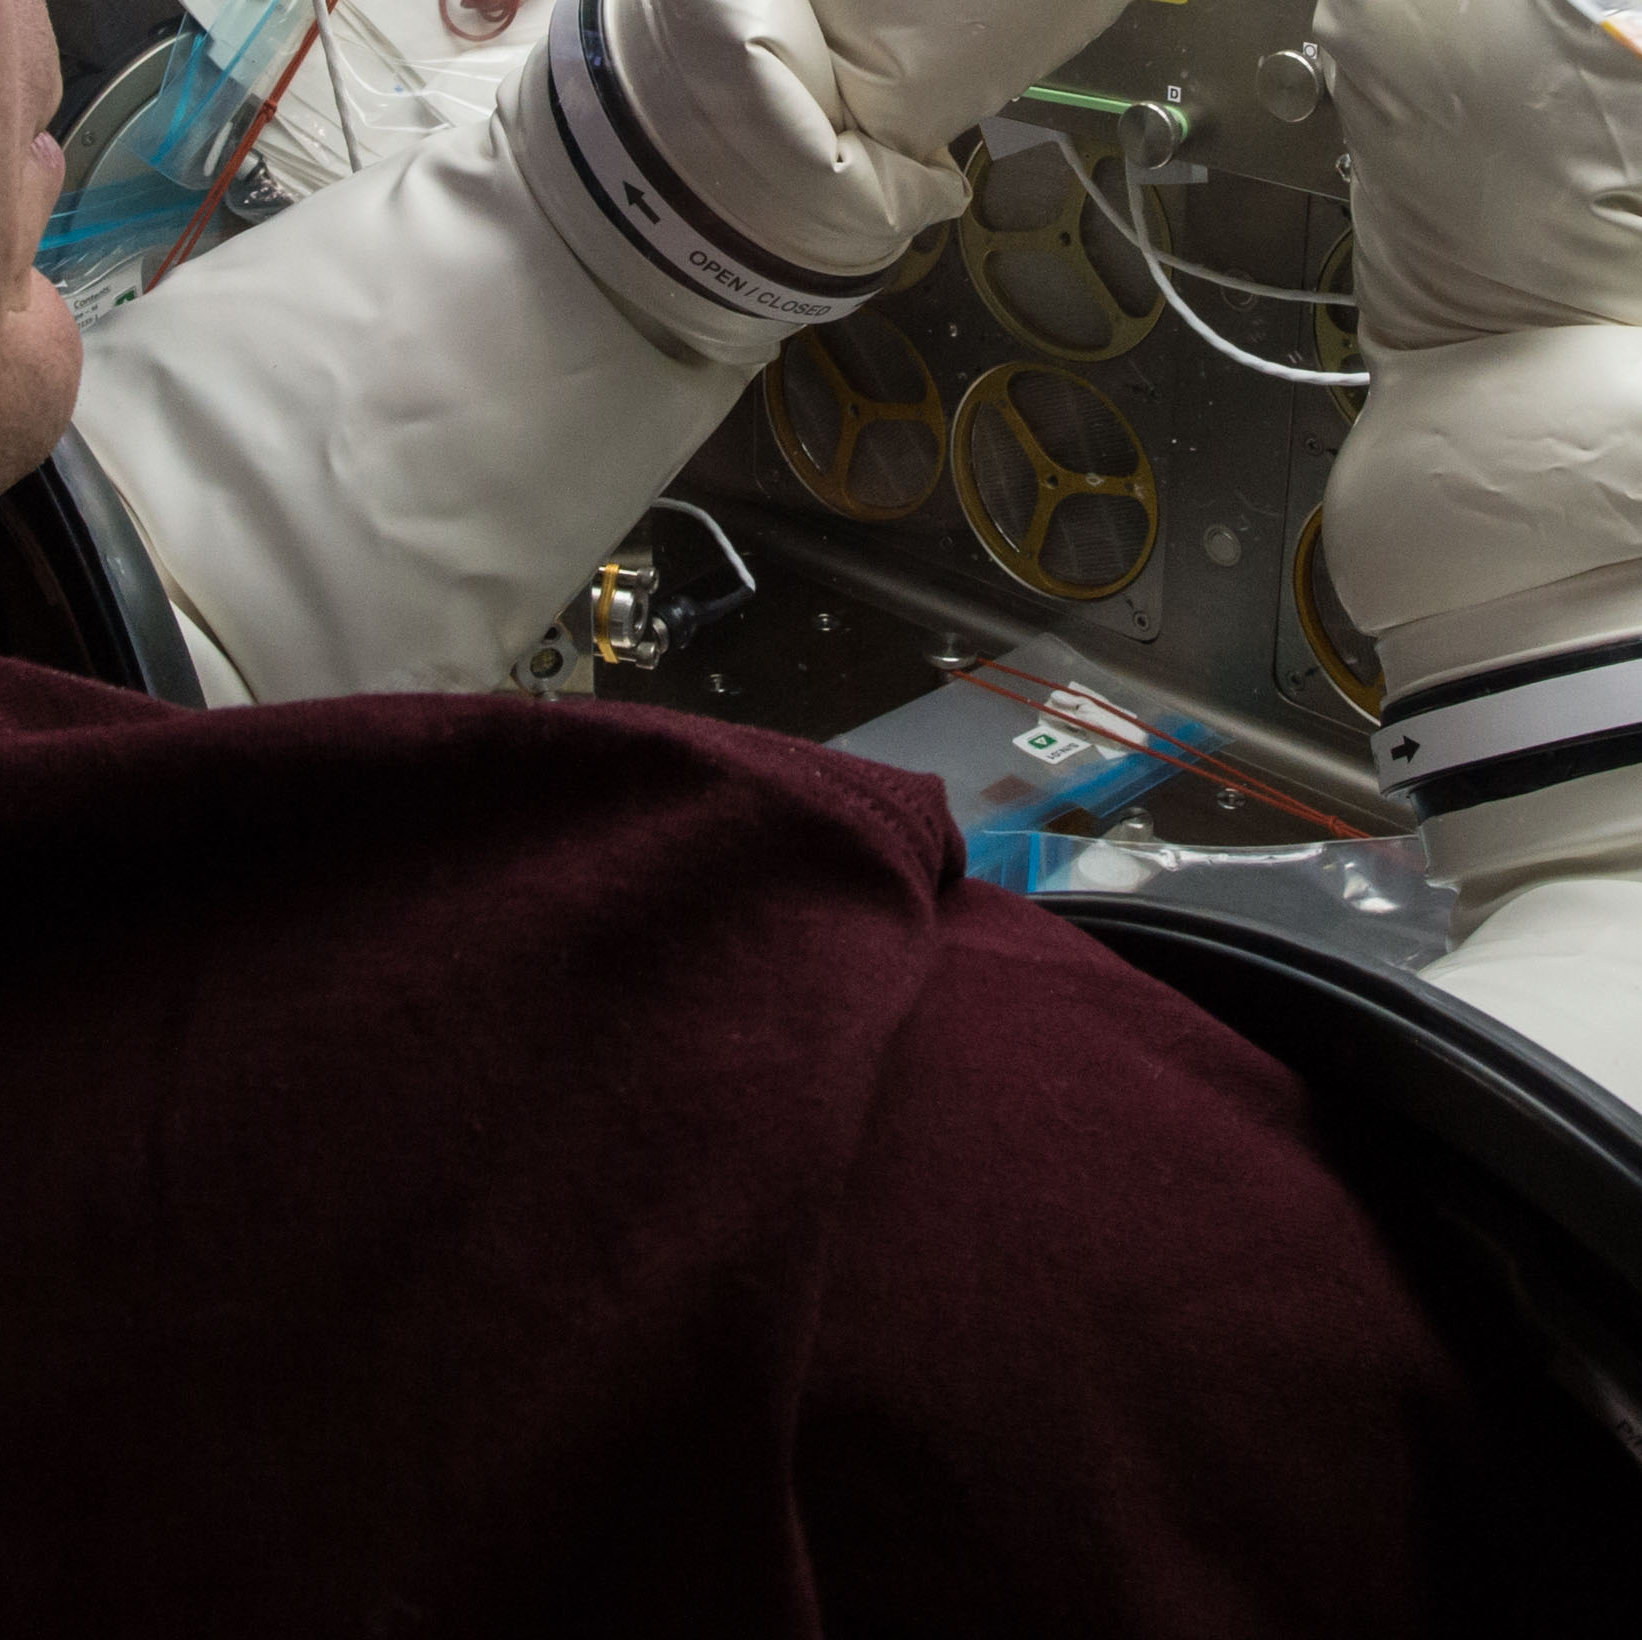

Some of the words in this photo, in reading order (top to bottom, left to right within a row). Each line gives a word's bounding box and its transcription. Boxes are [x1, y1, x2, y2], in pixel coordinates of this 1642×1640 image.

[1170, 88, 1178, 99] D
[689, 249, 748, 293] OPEN
[757, 291, 833, 318] CLOSED
